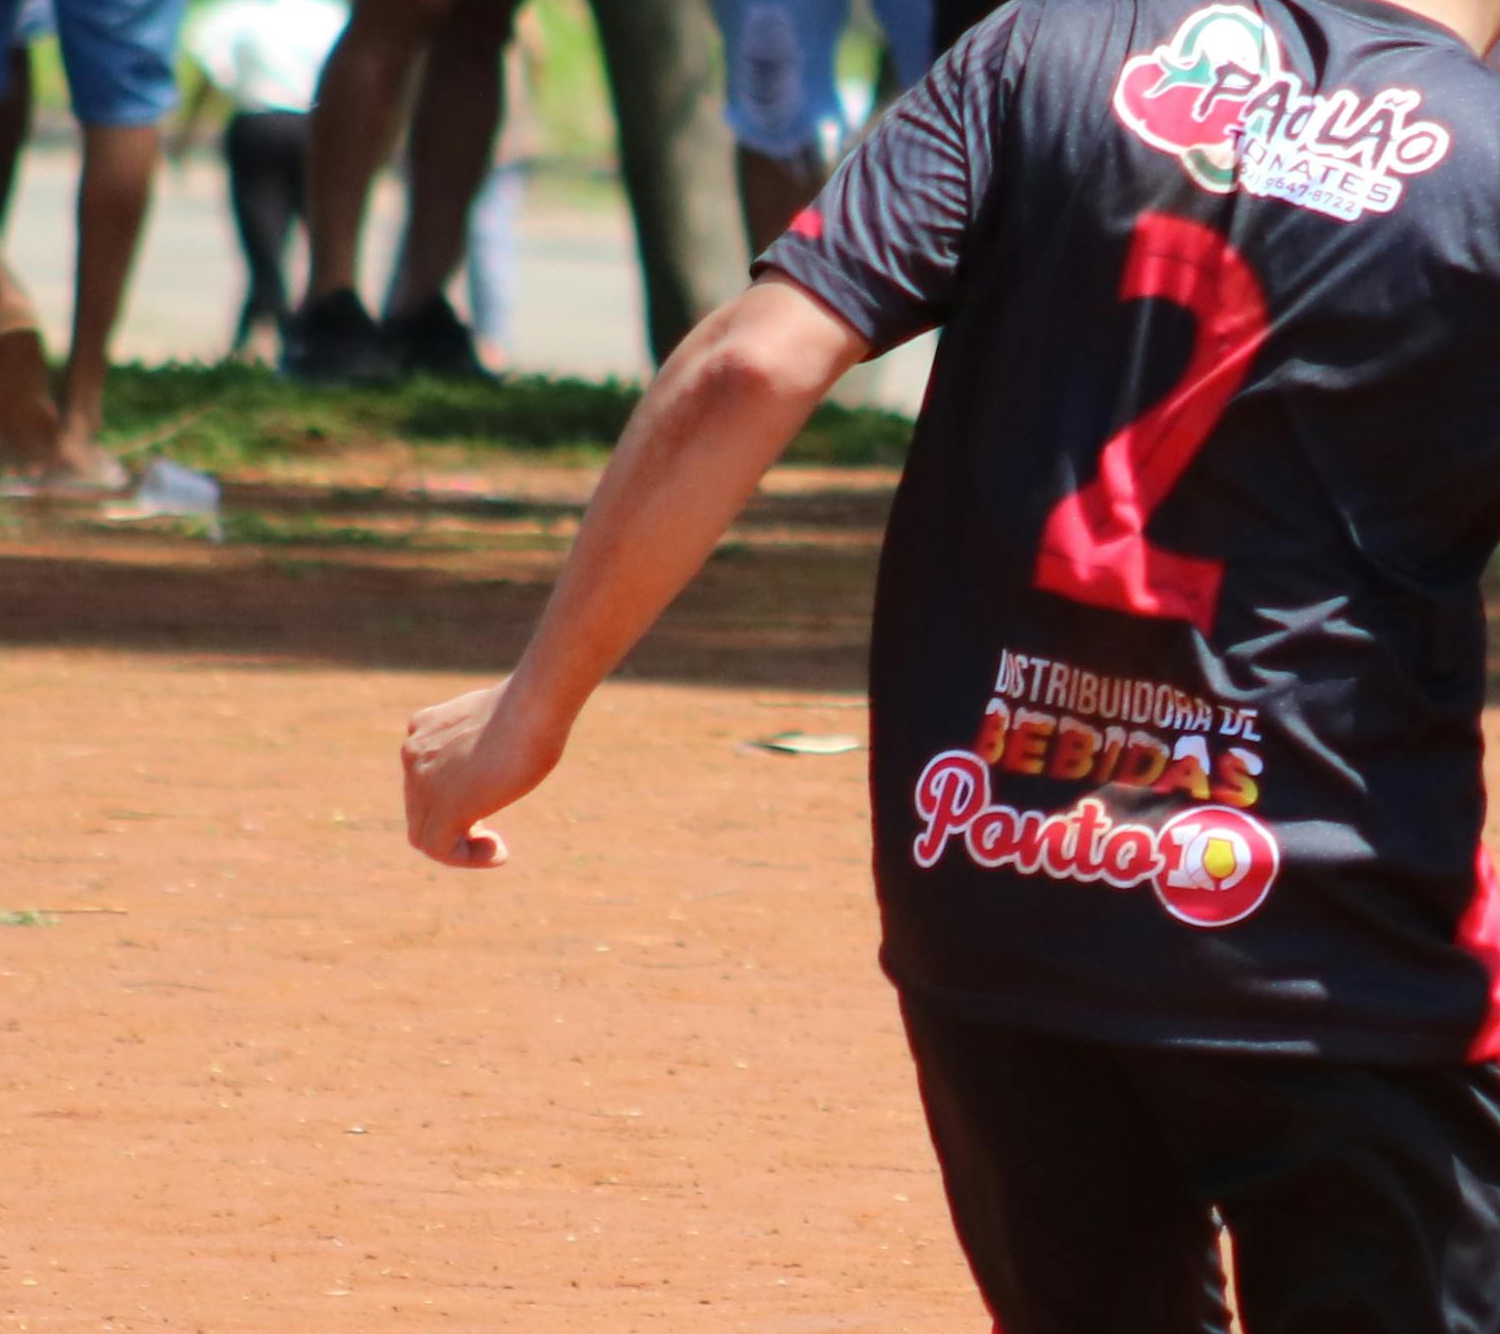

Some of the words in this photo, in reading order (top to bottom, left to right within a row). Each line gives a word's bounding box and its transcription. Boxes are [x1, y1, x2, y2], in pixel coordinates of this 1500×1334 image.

[1033, 211, 1269, 639] 2
[973, 697, 1265, 808] BEBIDAS
[995, 648, 1212, 732] DISTRIBUIDORA
[1218, 705, 1263, 742] DE
[914, 750, 1166, 889] Ponto
